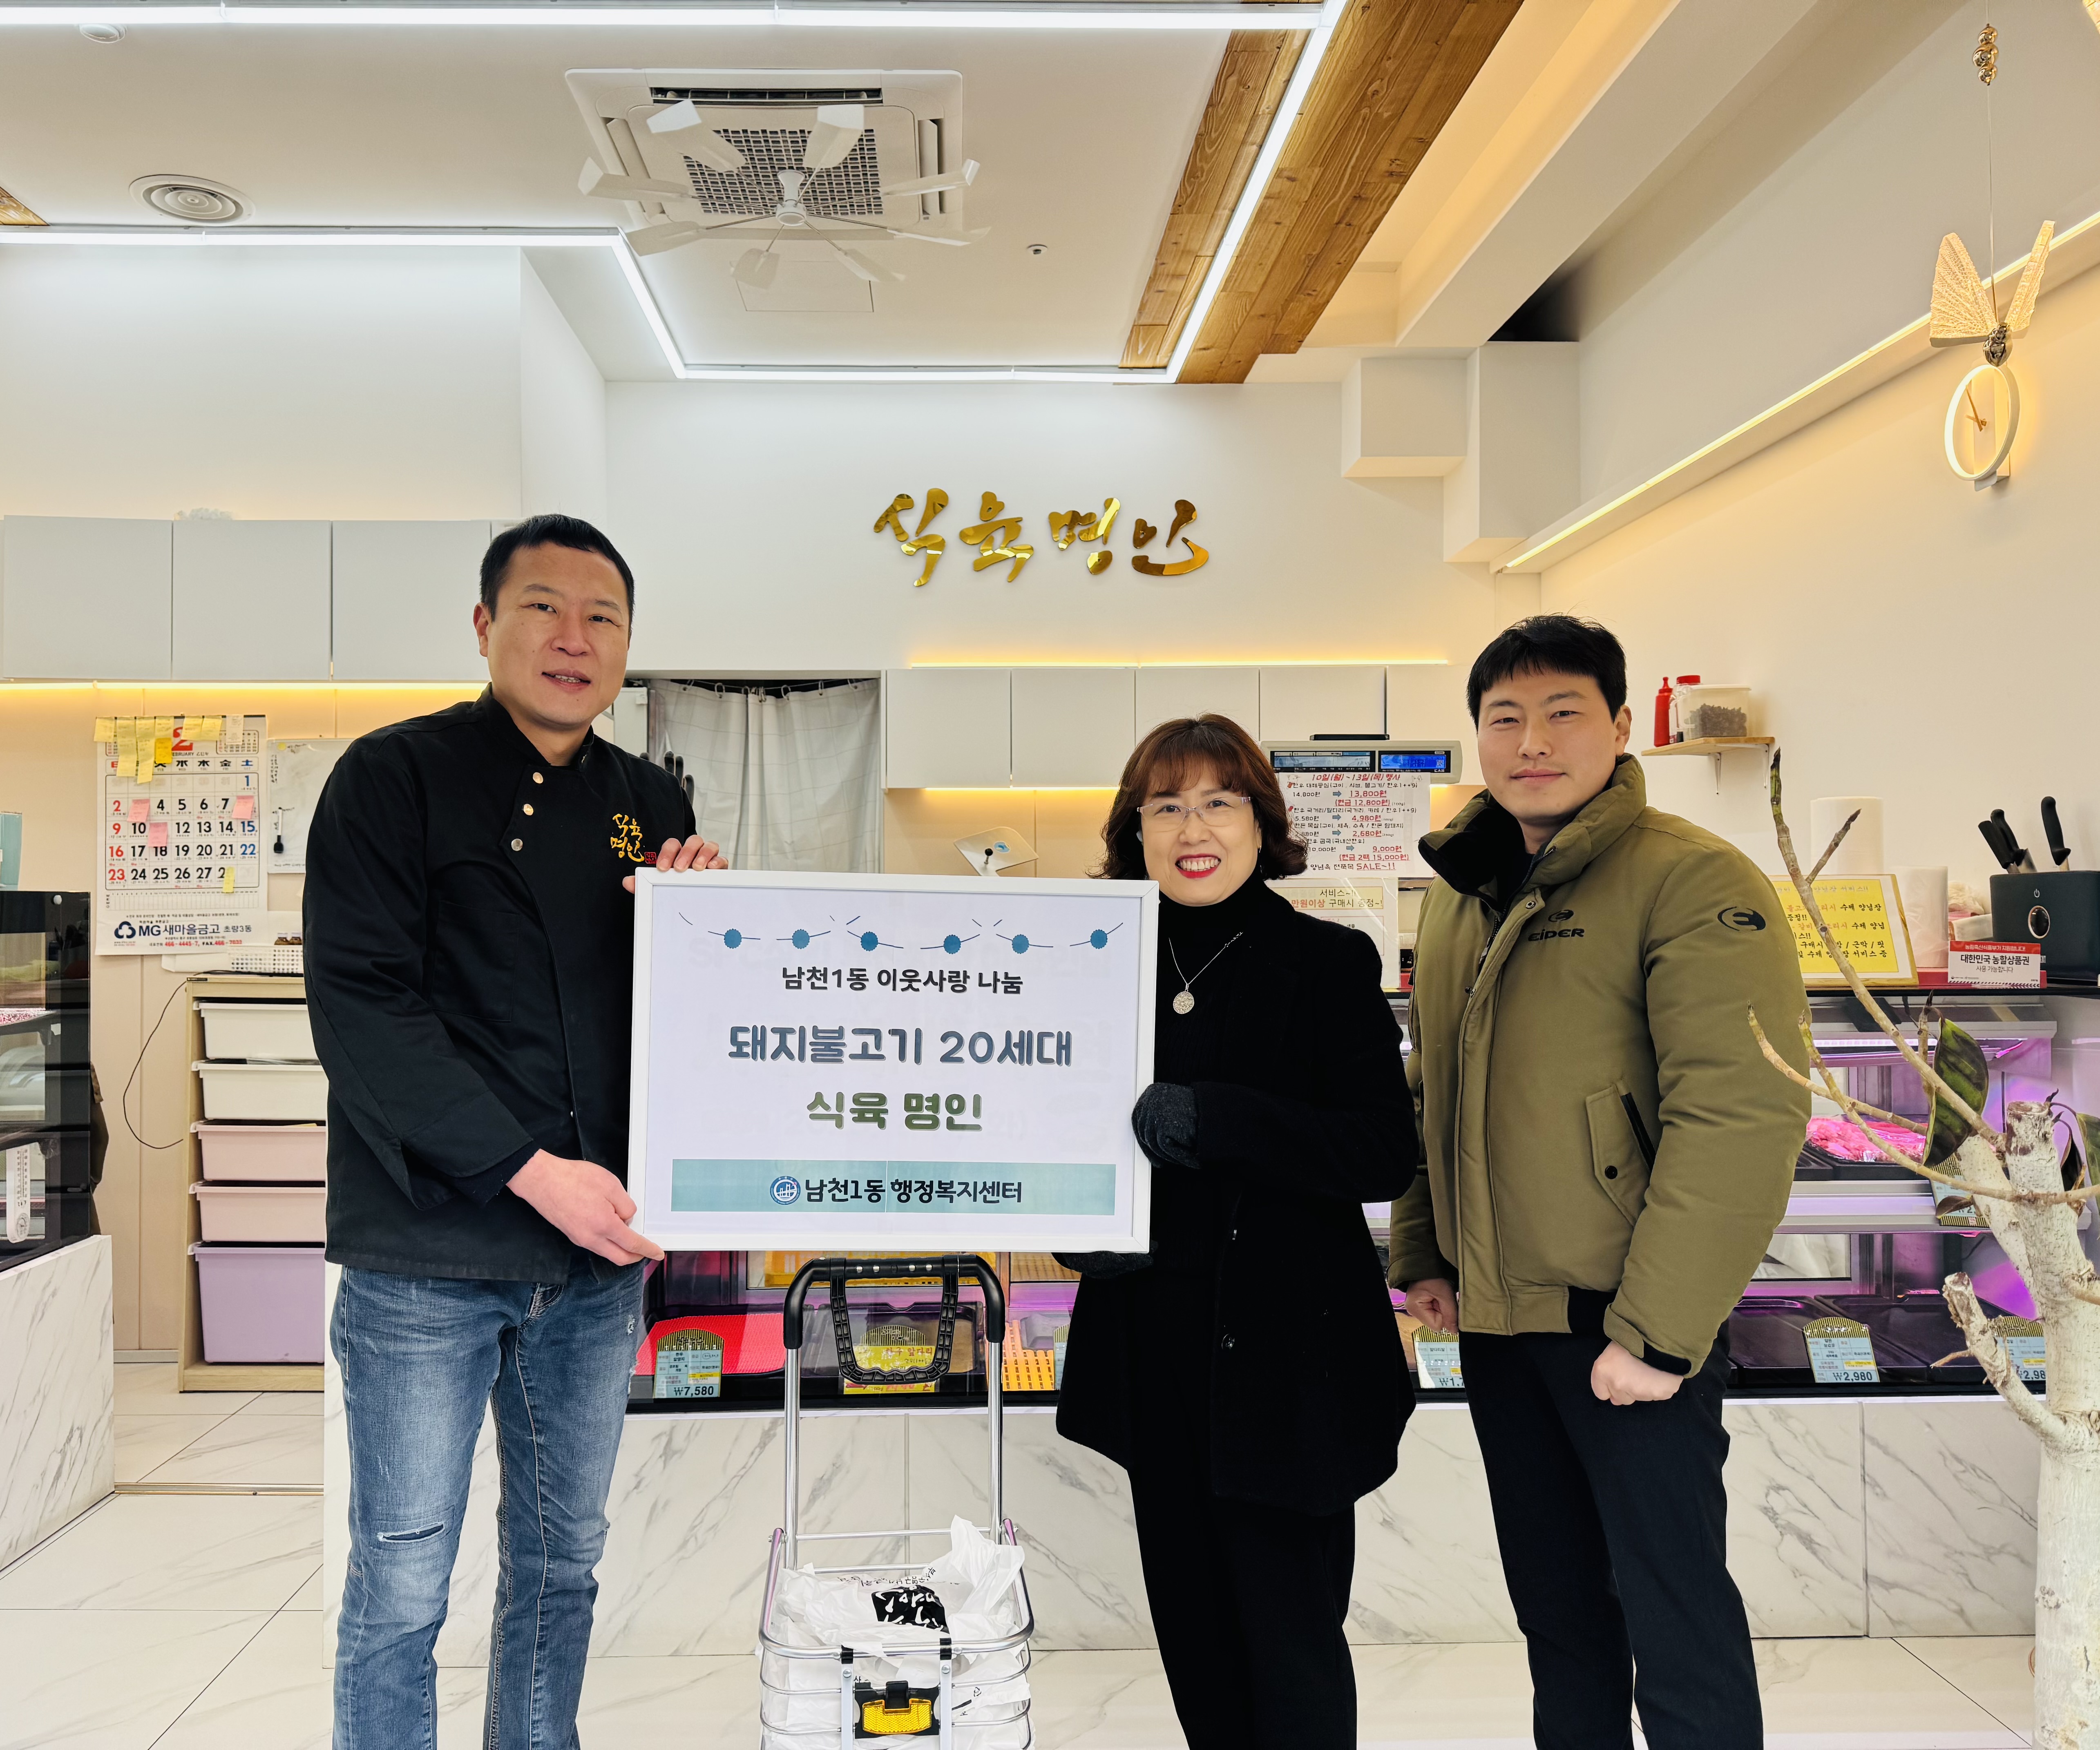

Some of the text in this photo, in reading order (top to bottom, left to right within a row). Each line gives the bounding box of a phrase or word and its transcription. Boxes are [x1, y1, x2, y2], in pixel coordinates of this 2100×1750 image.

[244, 775, 250, 787] 1
[113, 798, 229, 812] 2 4 5 6 7
[113, 821, 255, 835] 9 10 12 13 14 15
[109, 844, 256, 857] 16 17 18 19 20 21 22
[108, 869, 125, 880] 23
[131, 868, 147, 880] 24
[153, 868, 169, 879] 25
[174, 868, 190, 879] 26
[196, 867, 212, 879] 27
[1329, 899, 1354, 908] 구매시
[1807, 950, 1822, 958] 수제
[1853, 950, 1877, 958] 서비스
[1961, 954, 1991, 964] 대한민국
[1992, 955, 2030, 965] 농할상품권
[782, 966, 1023, 995] 남천1동 이웃사랑 나눔
[728, 1025, 1072, 1067] 돼지불고기 20세대
[806, 1091, 983, 1132] 식육 명인
[805, 1178, 1022, 1203] 남천1동 행정복지센터
[1833, 1372, 1872, 1382] ₩2,980
[674, 1386, 714, 1397] ₩7,580
